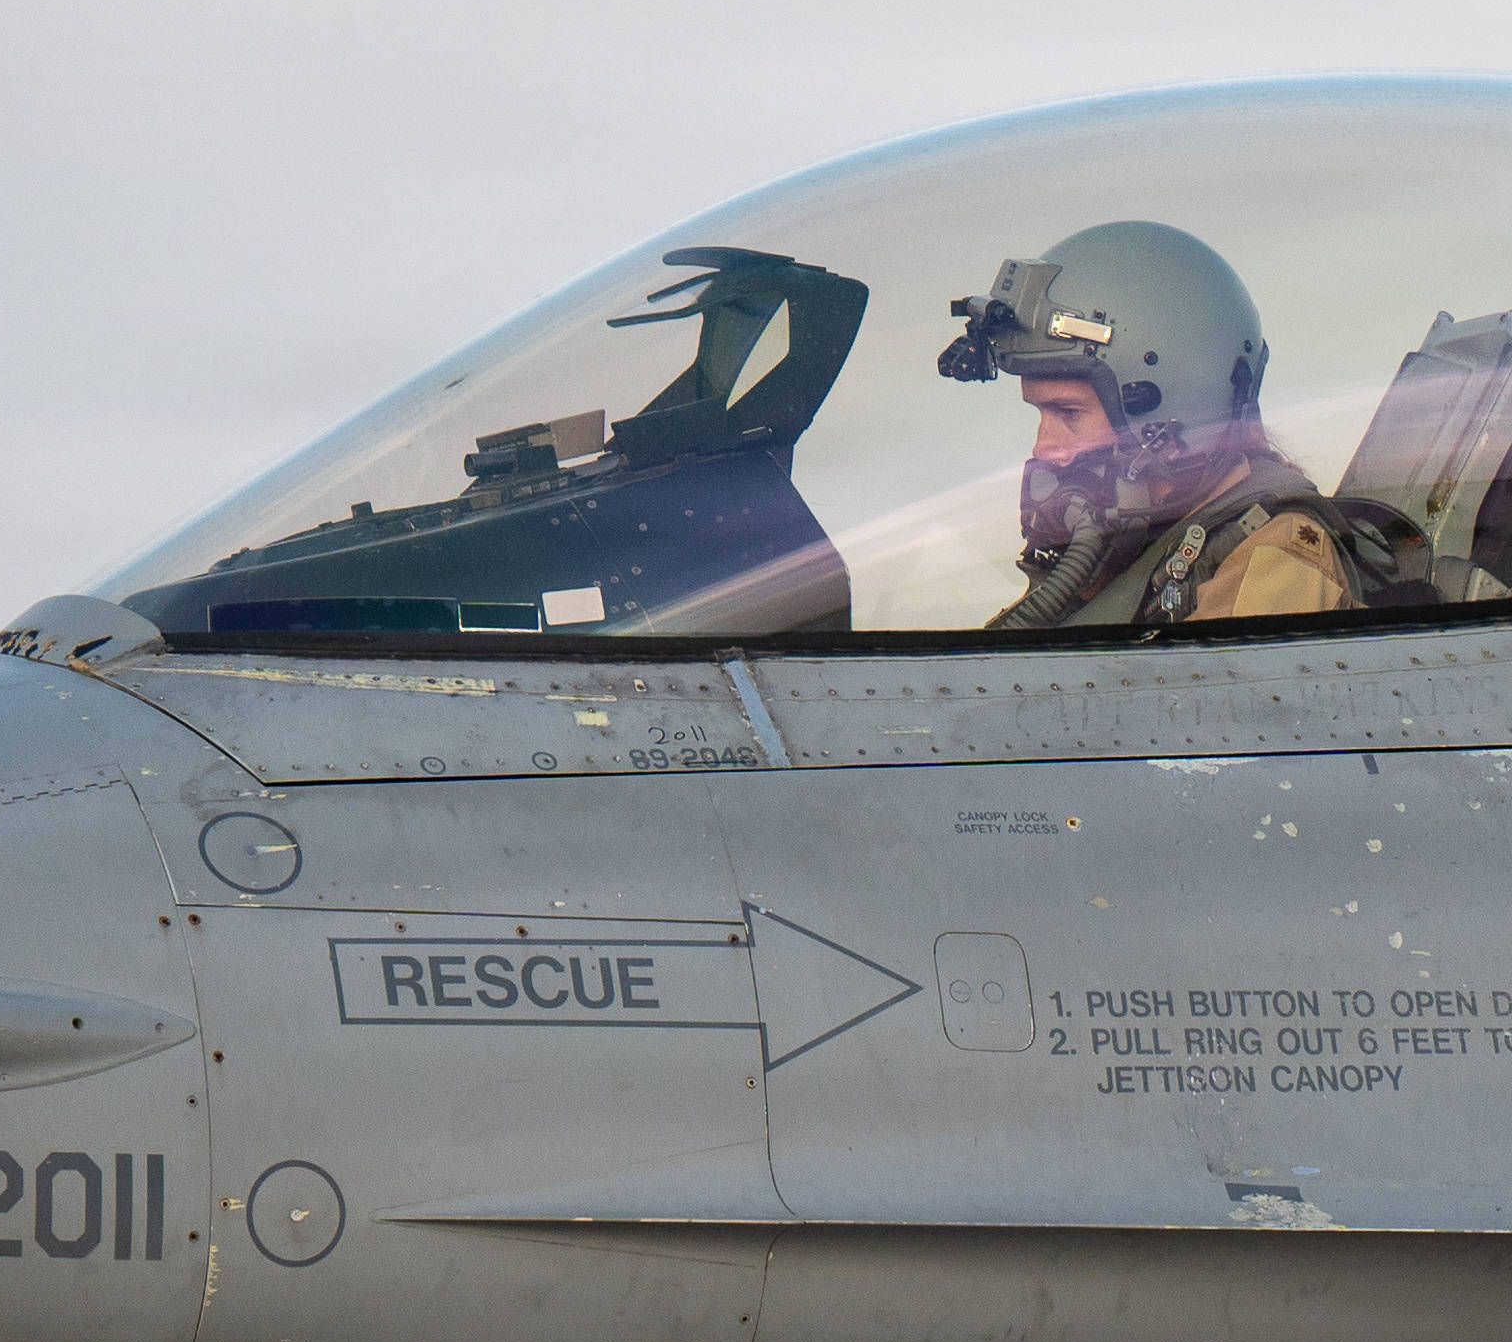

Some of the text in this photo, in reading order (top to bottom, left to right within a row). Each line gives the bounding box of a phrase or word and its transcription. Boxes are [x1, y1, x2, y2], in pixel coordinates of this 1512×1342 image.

[648, 725, 707, 745] 2011
[954, 823, 1059, 834] SAFETY ACCESS
[957, 811, 1049, 822] CANOPY LOCK
[380, 955, 660, 1010] RESCUE
[1049, 990, 1074, 1018] 1.
[1086, 990, 1175, 1018] PUSH
[1188, 990, 1318, 1018] BUTTON
[1330, 990, 1376, 1018] TO
[1390, 990, 1478, 1018] OPEN
[1048, 1028, 1077, 1057] 2.
[1091, 1028, 1172, 1056] PULL
[1185, 1028, 1263, 1056] RING
[1277, 1028, 1342, 1055] OUT
[1357, 1028, 1378, 1056] 6
[1393, 1028, 1470, 1055] FEET
[1096, 1065, 1404, 1093] JETTISON CANOPY
